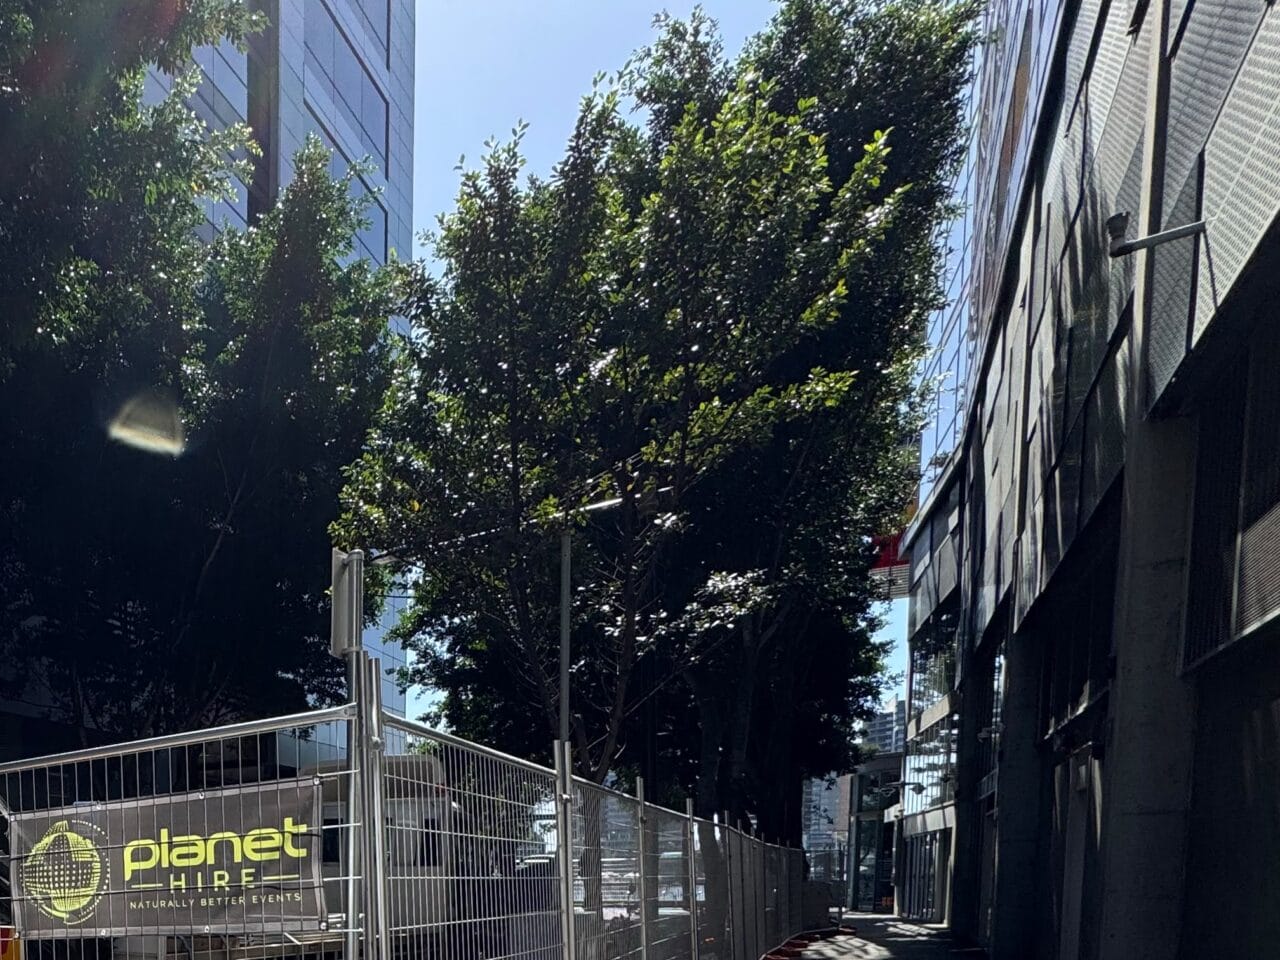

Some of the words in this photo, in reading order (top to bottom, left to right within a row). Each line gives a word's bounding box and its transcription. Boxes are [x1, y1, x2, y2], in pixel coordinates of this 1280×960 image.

[123, 816, 308, 881] planet
[170, 868, 256, 893] HIRE
[129, 898, 194, 910] NATURALLY
[200, 896, 245, 907] BETTER
[251, 892, 302, 904] EVENTS
